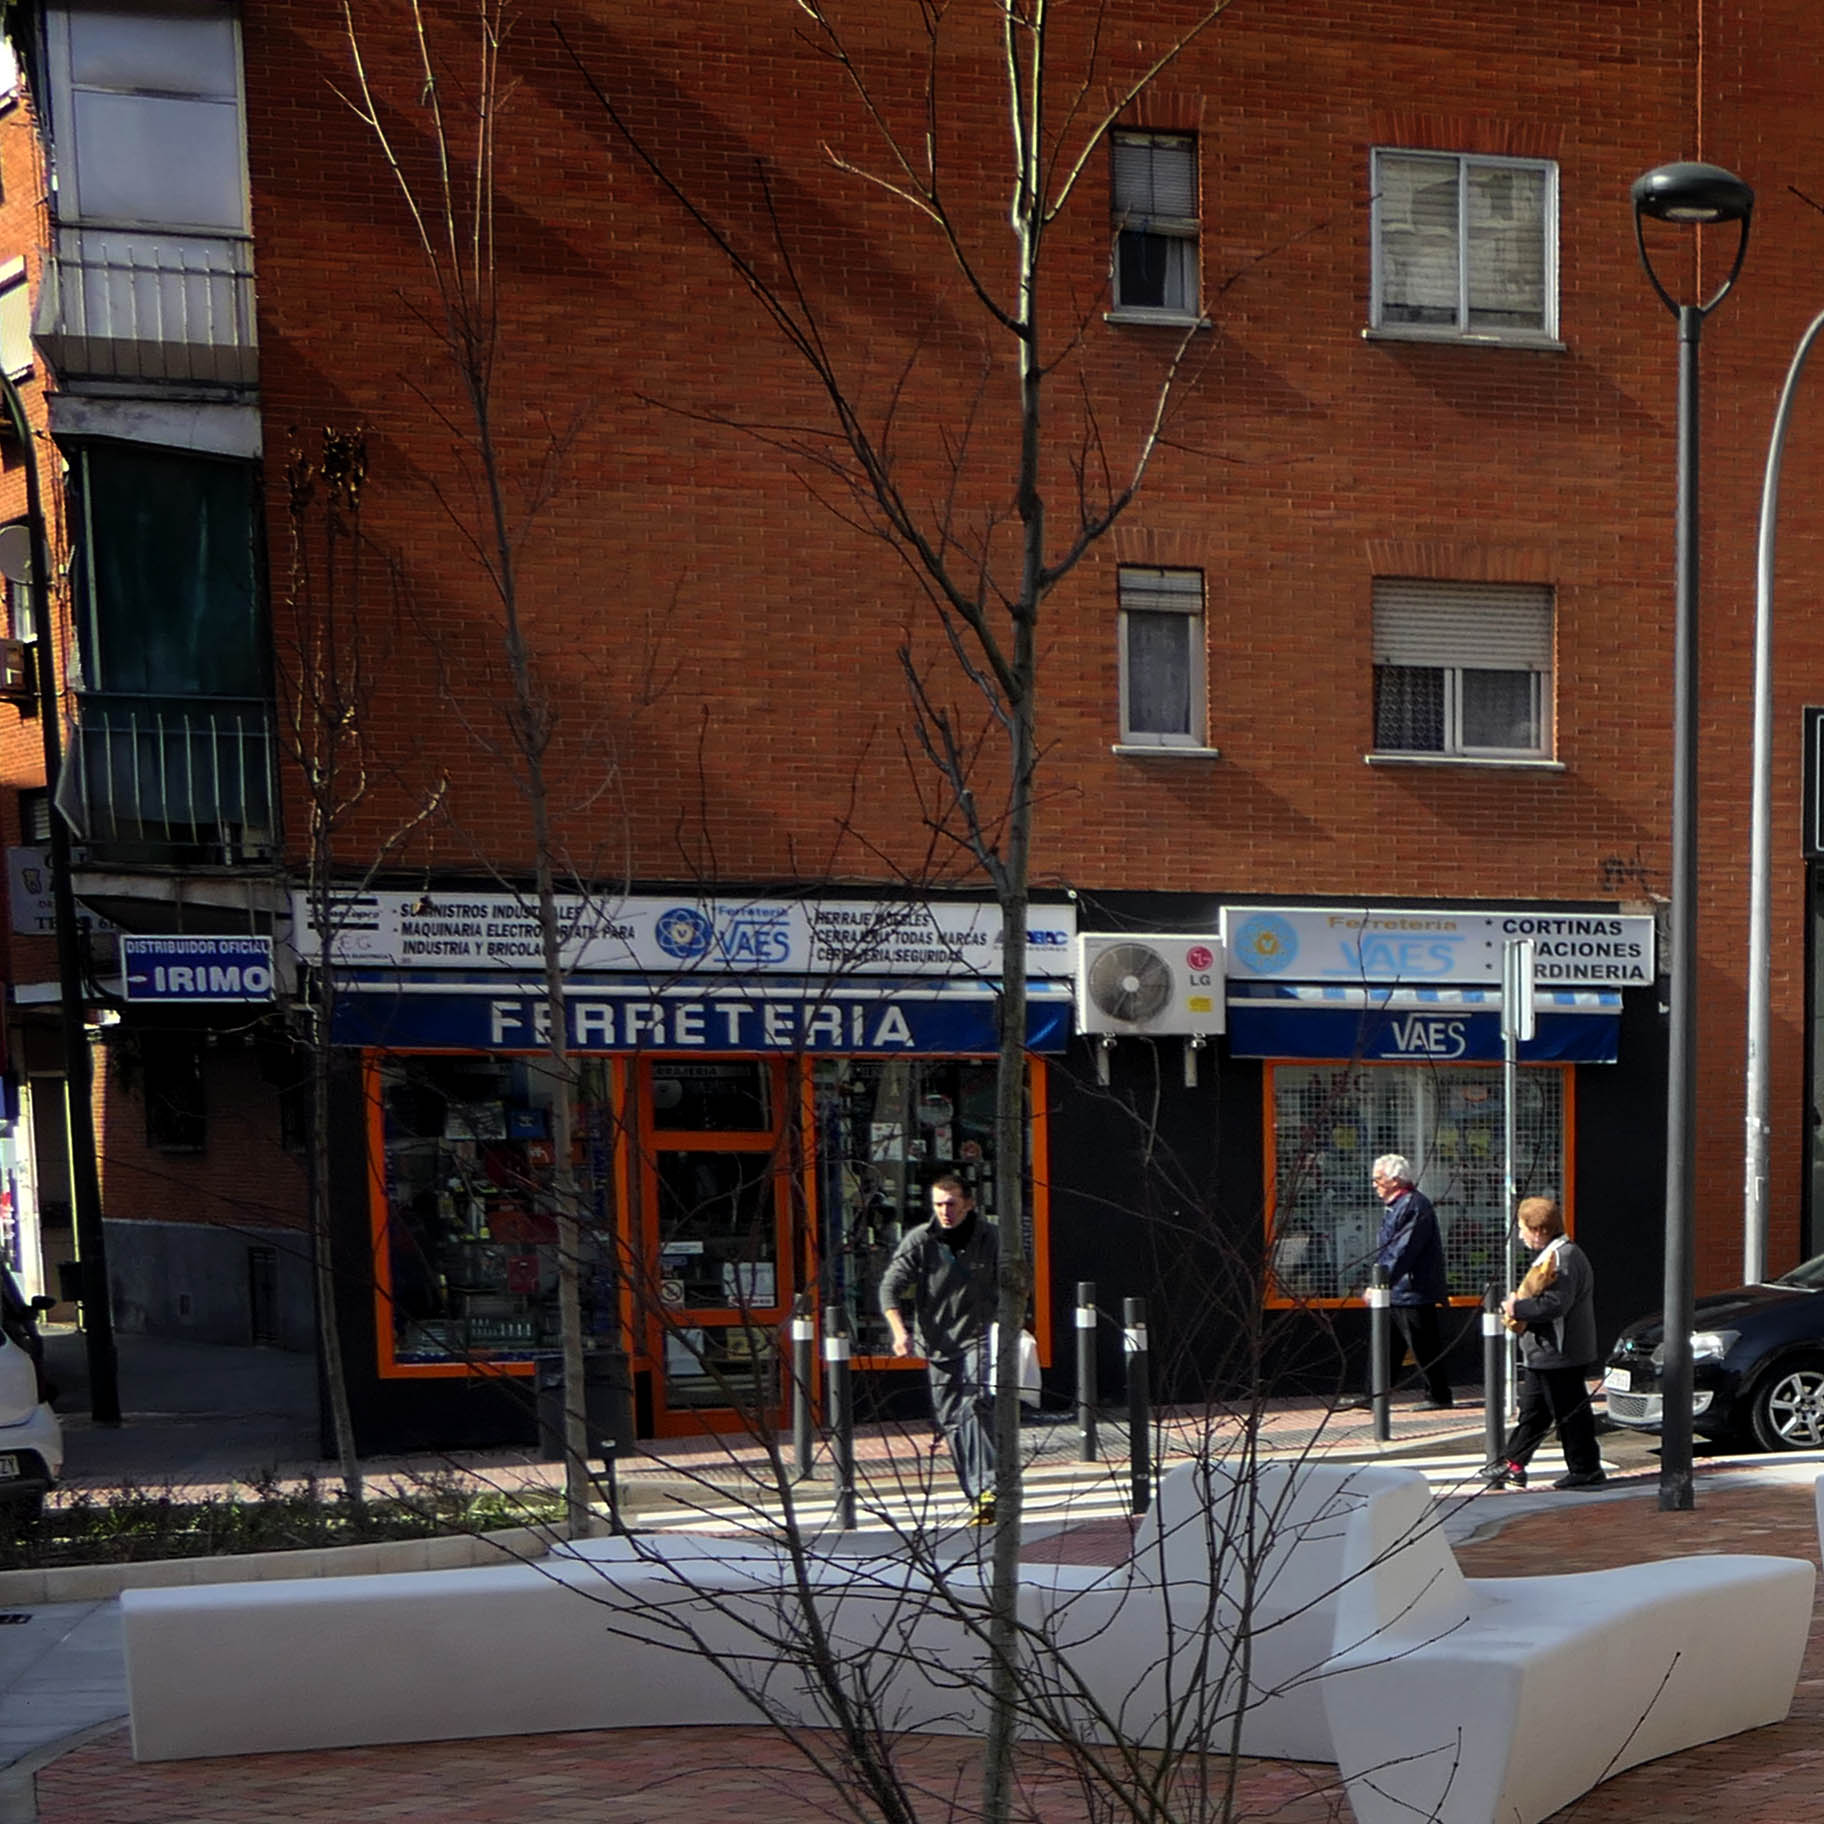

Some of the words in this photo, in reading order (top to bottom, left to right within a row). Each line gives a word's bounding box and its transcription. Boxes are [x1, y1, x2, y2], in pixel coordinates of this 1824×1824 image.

[401, 922, 483, 938] MAQUINARIA
[1503, 919, 1622, 935] CORTINAS
[895, 932, 933, 944] TODAS
[126, 940, 217, 955] DISTRIBUIDOR
[222, 941, 269, 955] OFICIAL
[402, 940, 470, 955] INDUSTRIA
[474, 942, 484, 956] Y
[153, 965, 271, 993] IRIMO
[1190, 975, 1212, 986] LG
[489, 1002, 916, 1047] FERRETERIA
